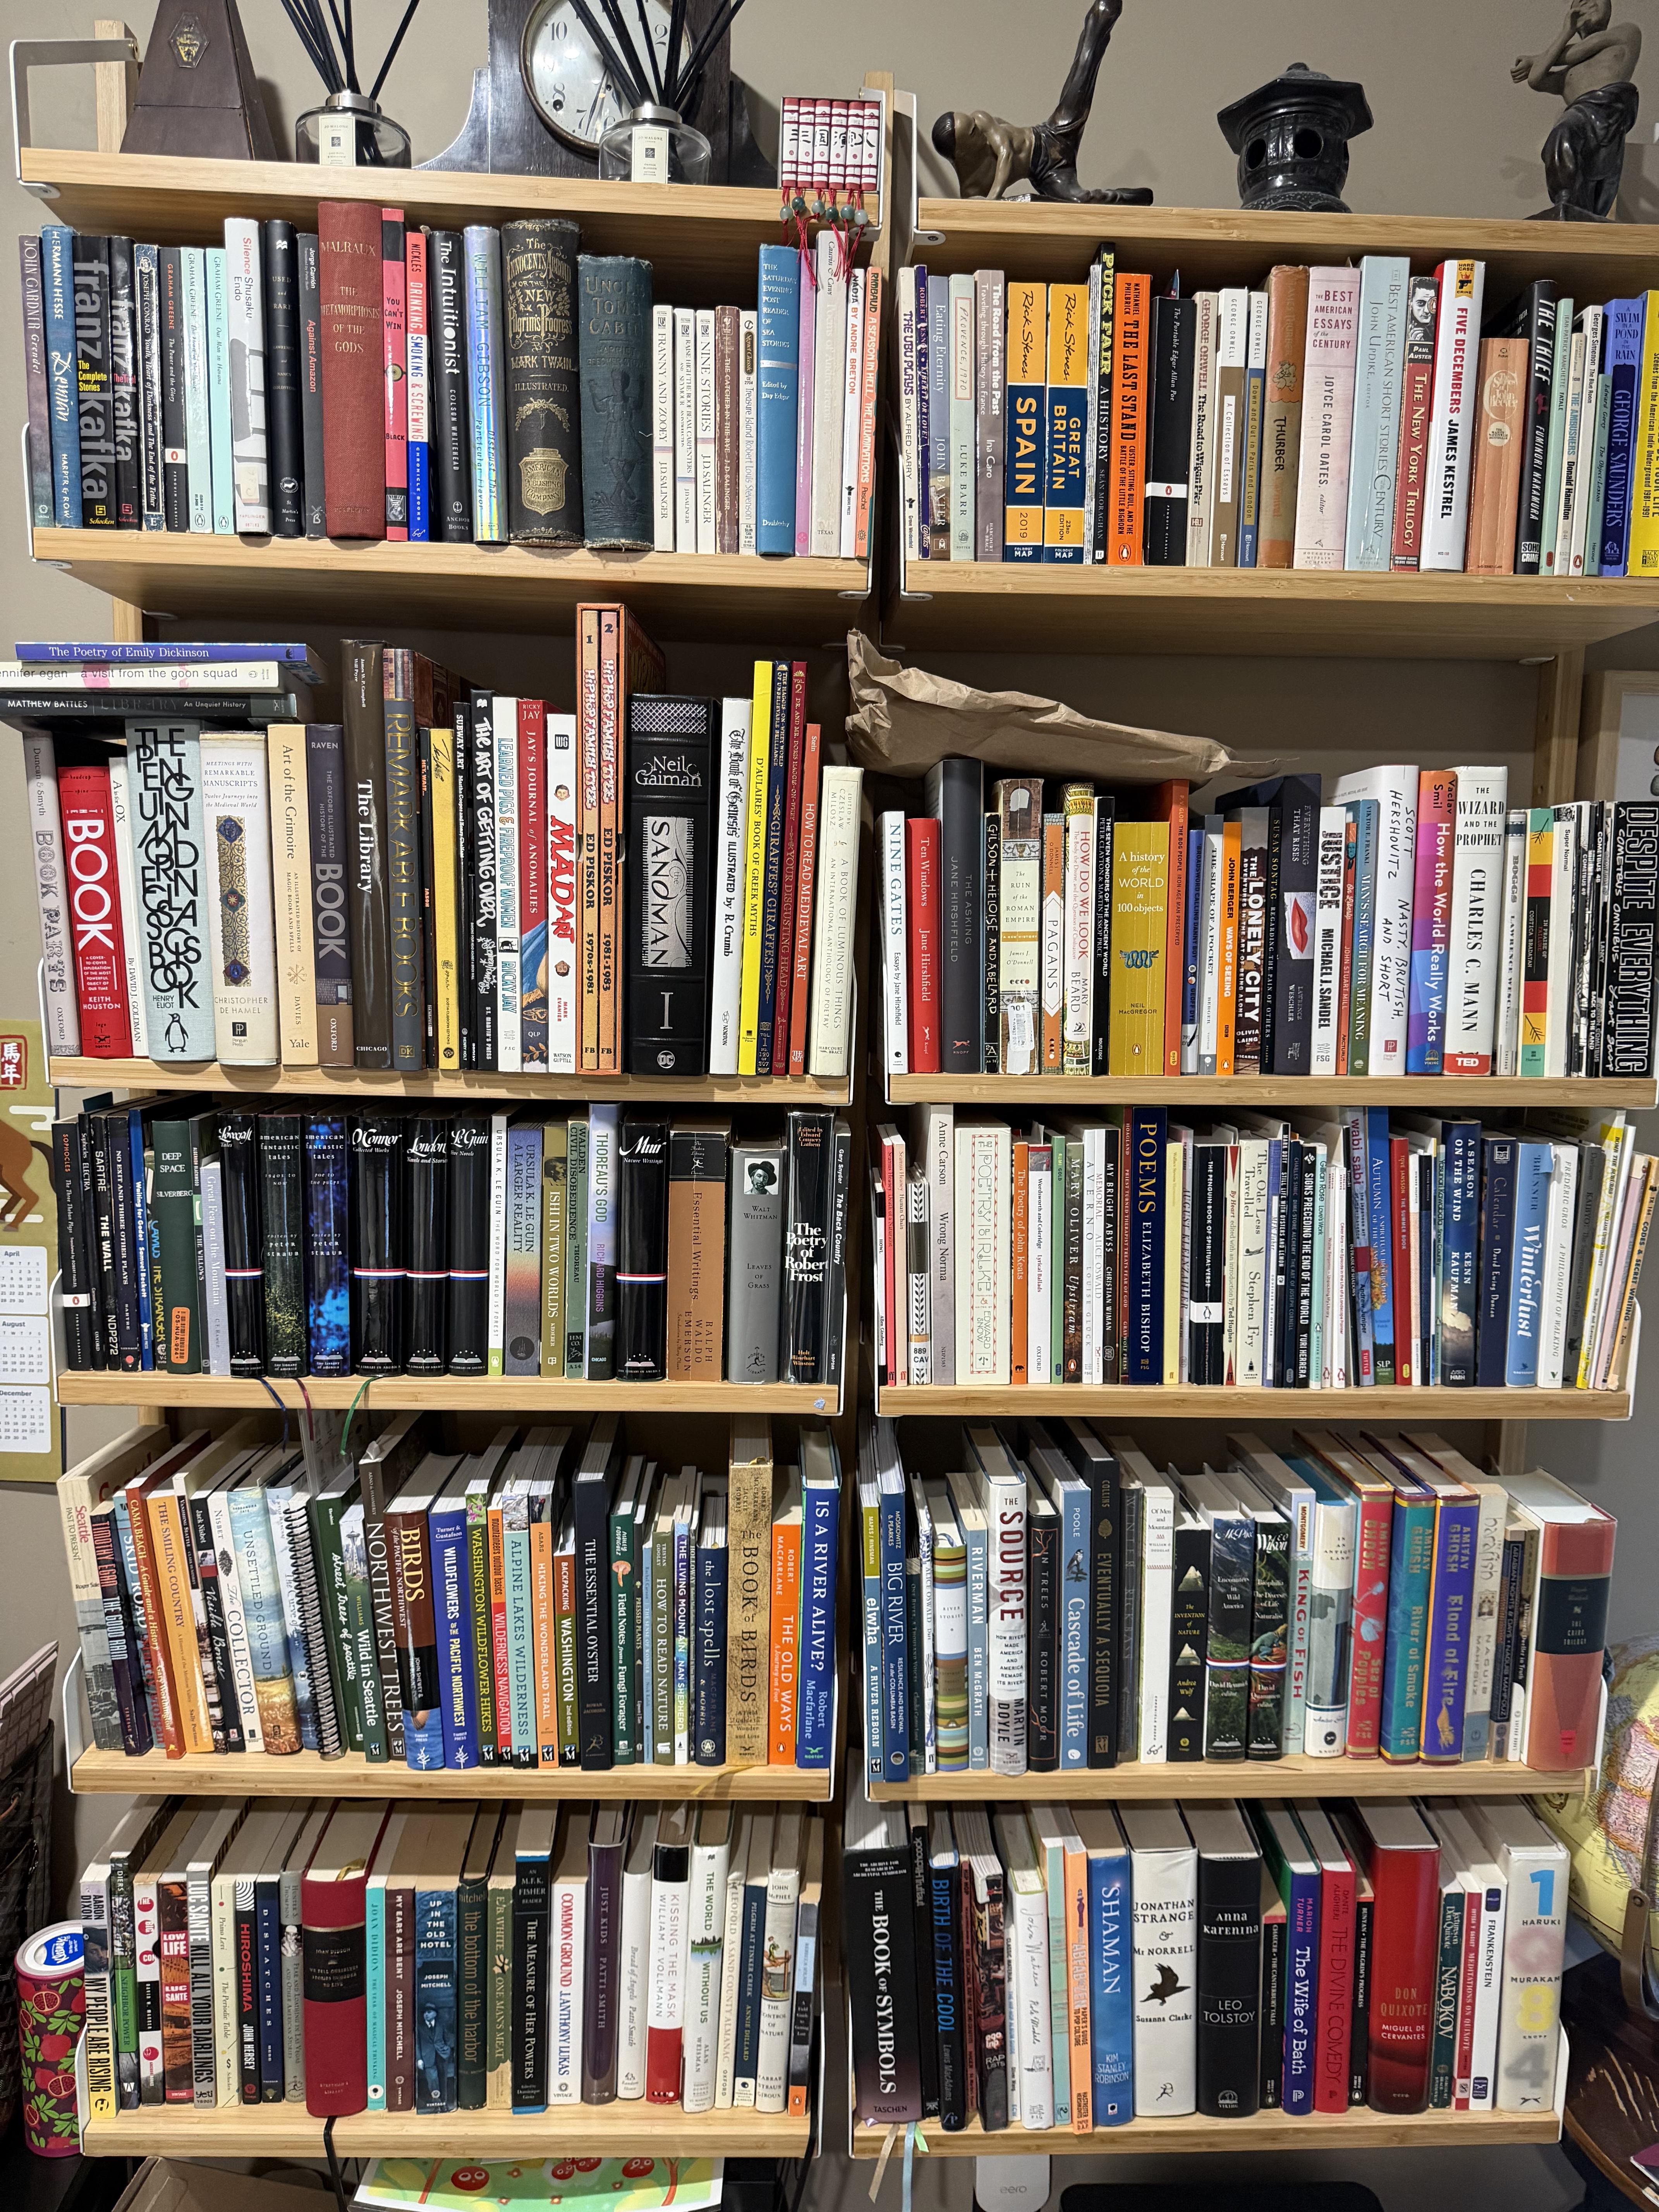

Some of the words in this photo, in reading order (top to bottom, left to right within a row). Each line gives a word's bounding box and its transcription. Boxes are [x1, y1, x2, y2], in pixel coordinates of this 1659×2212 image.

[550, 22, 567, 41] 10
[654, 25, 668, 46] 2
[24, 240, 39, 274] JOHN
[440, 241, 451, 263] The
[25, 277, 41, 331] GARDNER
[73, 260, 110, 359] franz
[245, 277, 253, 319] Shusaku
[1314, 306, 1352, 314] AMERICAN
[1324, 291, 1353, 302] BEST
[441, 266, 460, 375] Intuitionist
[1124, 322, 1139, 350] THE
[1314, 318, 1352, 330] ESSAYS
[1455, 307, 1468, 335] FIVE
[31, 334, 41, 374] Grendel
[335, 342, 364, 353] GODS
[658, 333, 666, 377] FRANNY
[1313, 338, 1350, 349] CENTURY
[78, 361, 90, 370] The
[78, 372, 108, 382] Complete
[511, 356, 538, 369] MARK
[1122, 354, 1137, 392] LAST
[1449, 339, 1466, 414] DECEMBERS
[79, 382, 101, 392] Stories
[515, 382, 569, 392] ILLUSTRATED.
[659, 408, 667, 442] ZOOEY
[1121, 395, 1137, 441] STAND
[1611, 389, 1632, 449] GEORGE
[79, 392, 116, 499] kafka
[1015, 397, 1037, 494] SPAIN
[1053, 405, 1066, 489] BRITAIN
[1069, 418, 1081, 478] GREAT
[1445, 419, 1460, 461] JAMES
[1441, 465, 1456, 519] KESTREL
[1606, 453, 1628, 526] SAUNDERS
[605, 623, 613, 634] 2
[49, 647, 69, 657] The
[74, 647, 108, 658] Poetry
[112, 647, 122, 657] of
[125, 647, 155, 658] Emily
[159, 647, 209, 657] Dickinson
[91, 668, 115, 678] visit
[118, 668, 144, 678] from
[149, 668, 167, 678] the
[170, 670, 199, 681] goon
[203, 668, 237, 681] squad
[54, 700, 88, 708] BATTLES
[635, 770, 702, 788] Gaiman
[652, 756, 686, 773] Neil
[356, 780, 373, 816] The
[1458, 801, 1504, 815] WIZARD
[357, 819, 373, 895] Library
[889, 824, 901, 872] NINE
[1119, 853, 1126, 862] A
[1130, 852, 1165, 864] history
[1456, 834, 1503, 846] PROPHET
[1622, 807, 1658, 910] DESPITE
[67, 819, 113, 950] BOOK
[1119, 878, 1164, 888] WORLD
[1319, 831, 1343, 910] JUSTICE
[315, 863, 347, 960] BOOK
[891, 878, 902, 935] GATES
[1118, 904, 1132, 912] 100
[1133, 903, 1163, 914] objects
[1246, 878, 1263, 963] LONELY
[1046, 920, 1058, 988] PAGANS
[1243, 973, 1261, 1022] CITY
[1614, 923, 1654, 1073] EVERYTHING
[1, 1042, 21, 1084] 馬年
[1456, 1058, 1479, 1067] TED
[939, 1121, 947, 1148] Anne
[160, 1164, 185, 1173] SPACE
[162, 1152, 182, 1161] DEEP
[939, 1151, 948, 1185] Carson
[1138, 1122, 1158, 1213] POEMS
[156, 1189, 193, 1197] SILVERBERG
[786, 1232, 828, 1248] Poetry
[794, 1223, 822, 1236] The
[939, 1212, 949, 1243] Wrong
[785, 1257, 828, 1270] Robert
[800, 1246, 814, 1258] of
[939, 1247, 948, 1281] Norma
[1141, 1222, 1152, 1298] ELIZABETH
[790, 1272, 823, 1282] Frost
[1450, 1252, 1460, 1309] KAUFMAN
[1245, 1271, 1261, 1321] Stephen
[1139, 1303, 1151, 1352] BISHOP
[1244, 1324, 1259, 1348] Fry
[815, 1501, 829, 1518] IS
[814, 1524, 828, 1537] A
[400, 1528, 425, 1602] BIRDS
[741, 1546, 759, 1614] BOOK
[812, 1543, 829, 1601] RIVER
[999, 1511, 1024, 1622] SOURCE
[971, 1547, 983, 1625] RIVERMAN
[1296, 1569, 1310, 1622] KING
[744, 1613, 756, 1622] of
[866, 1598, 881, 1646] elwha
[1067, 1598, 1085, 1674] Cascade
[1297, 1628, 1305, 1642] OF
[811, 1606, 827, 1672] ALIVE?
[227, 1611, 255, 1715] COLLECTOR
[560, 1618, 575, 1702] WASHINGTON
[741, 1629, 757, 1702] BIRDS
[1293, 1647, 1307, 1698] FISH
[1068, 1678, 1080, 1694] of
[1066, 1698, 1085, 1738] Life
[706, 1872, 714, 1892] THE
[704, 1895, 714, 1931] WORLD
[1133, 1900, 1194, 1911] JONATHAN
[1133, 1911, 1194, 1924] STRANGE
[163, 1942, 187, 1955] LIFE
[872, 1915, 891, 1975] BOOK
[1101, 1887, 1121, 1994] SHAMAN
[1484, 1920, 1496, 1988] FRANKENSTEIN
[240, 1924, 253, 2012] HIROSHIMA
[701, 1962, 710, 2008] WITHOUT
[878, 1978, 887, 1992] OF
[700, 2010, 708, 2024] US
[1439, 1967, 1458, 2039] NABOKOV
[1517, 1985, 1555, 2032] 8
[875, 1995, 896, 2094] SYMBOLS
[1000, 2185, 1026, 2194] eero
